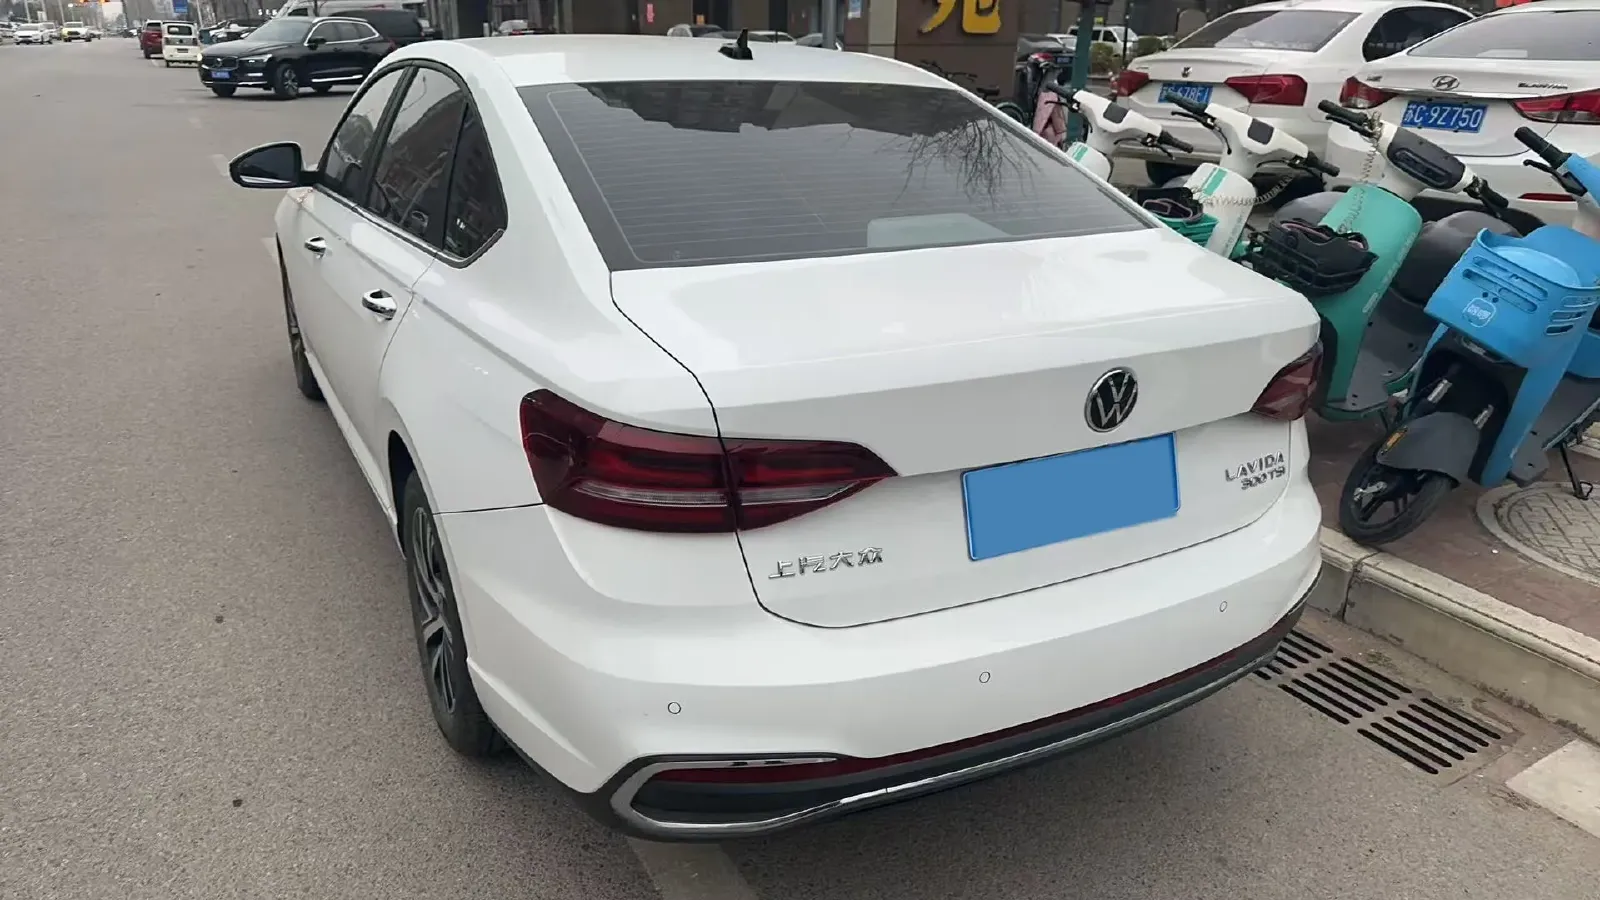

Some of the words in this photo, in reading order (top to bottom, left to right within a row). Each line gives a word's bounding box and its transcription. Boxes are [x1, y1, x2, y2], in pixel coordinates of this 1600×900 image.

[1225, 452, 1284, 482] LAVIDA
[768, 547, 883, 579] 上汽大众
